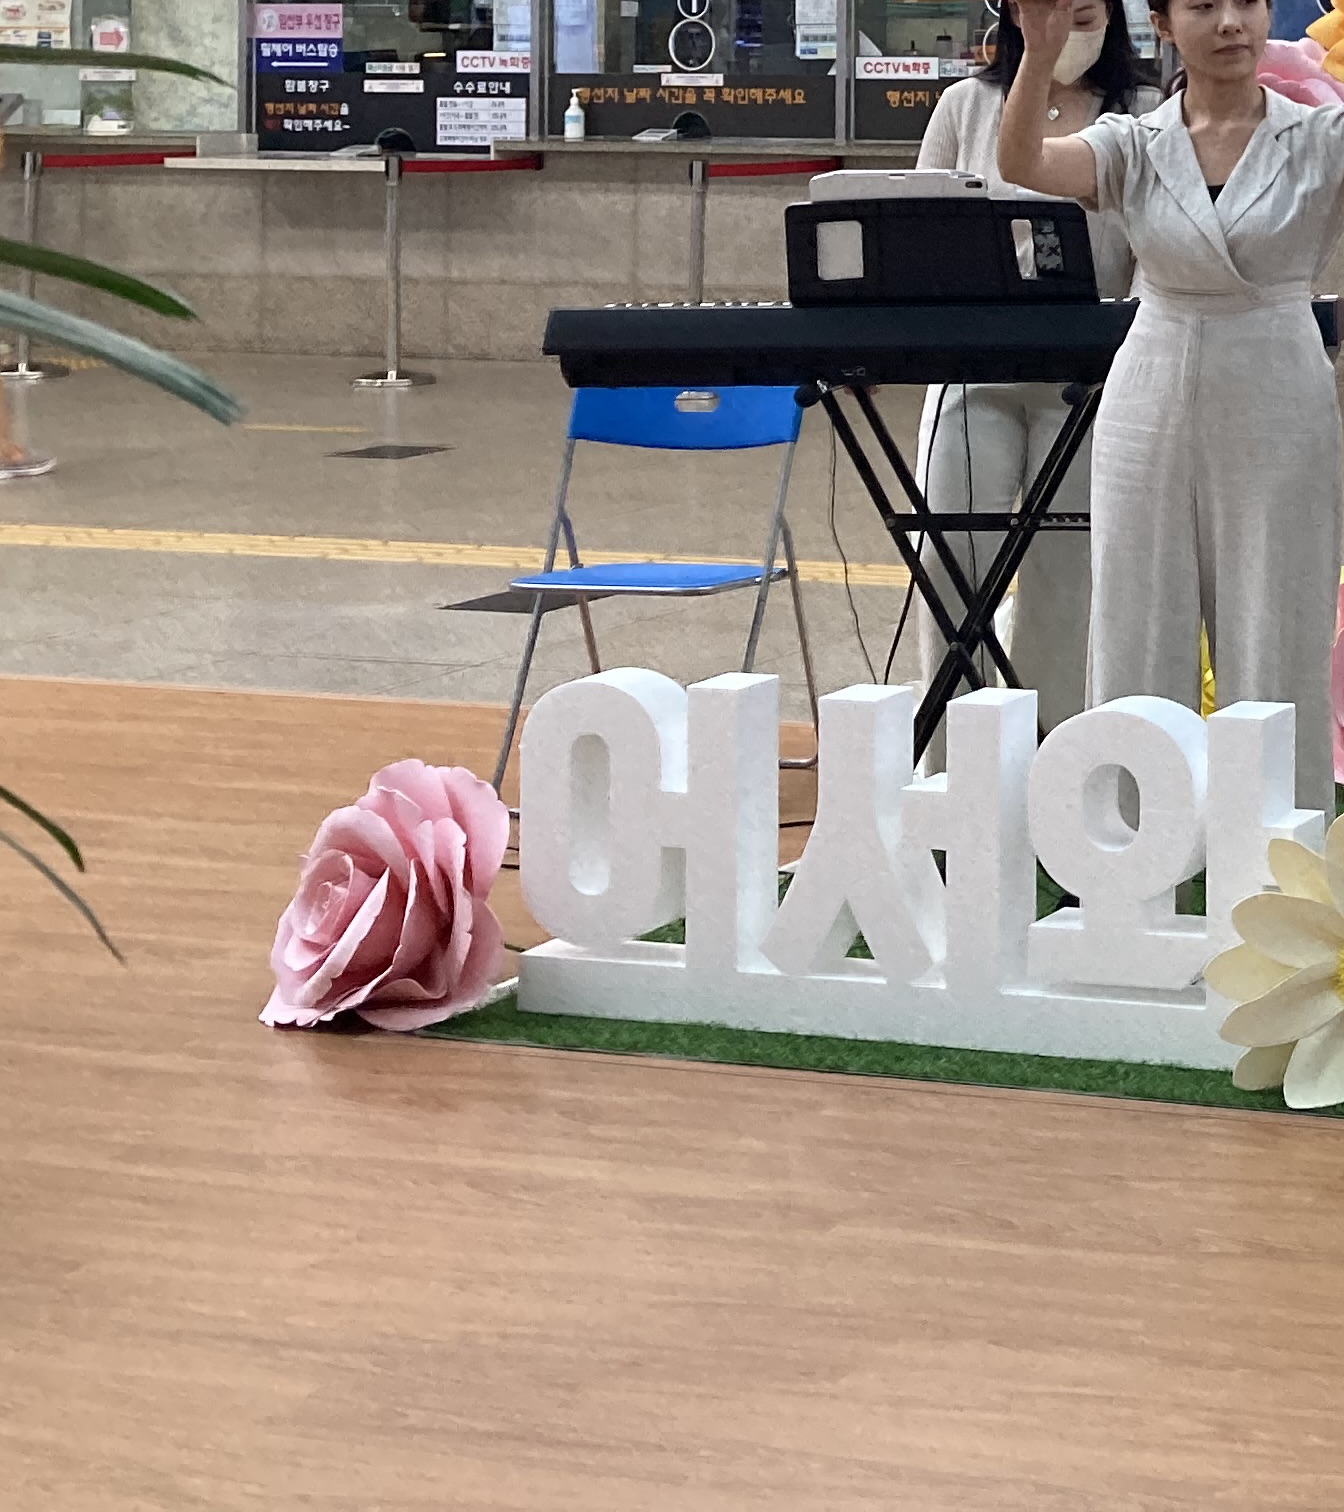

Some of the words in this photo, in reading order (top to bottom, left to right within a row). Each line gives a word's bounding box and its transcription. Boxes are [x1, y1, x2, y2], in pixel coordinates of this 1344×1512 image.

[656, 88, 697, 104] 시간을
[720, 88, 806, 104] 확인해주세요
[518, 666, 1325, 991] 어서와
